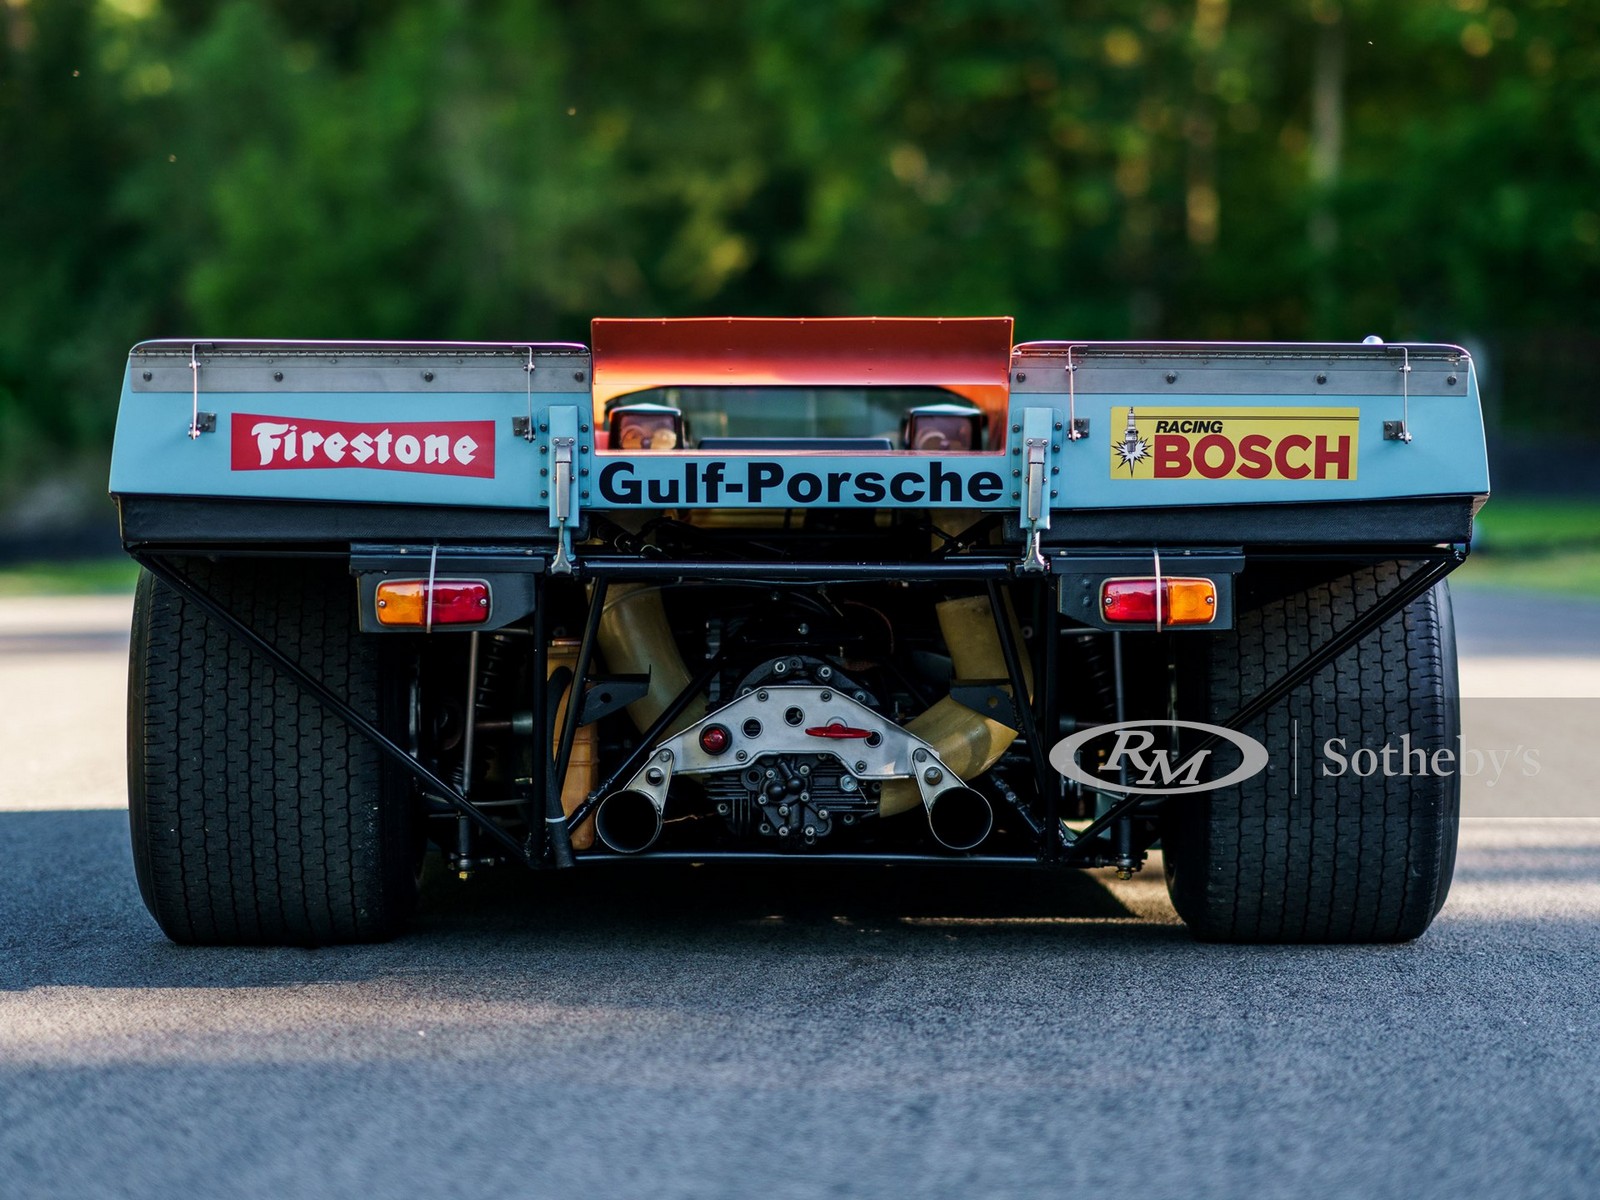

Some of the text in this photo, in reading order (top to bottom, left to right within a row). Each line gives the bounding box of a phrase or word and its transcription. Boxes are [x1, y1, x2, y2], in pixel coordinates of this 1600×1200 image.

[251, 422, 479, 466] Firestone
[1155, 420, 1223, 434] RACING
[1153, 434, 1350, 480] BOSCH
[598, 461, 1004, 505] Gulf-Porsche
